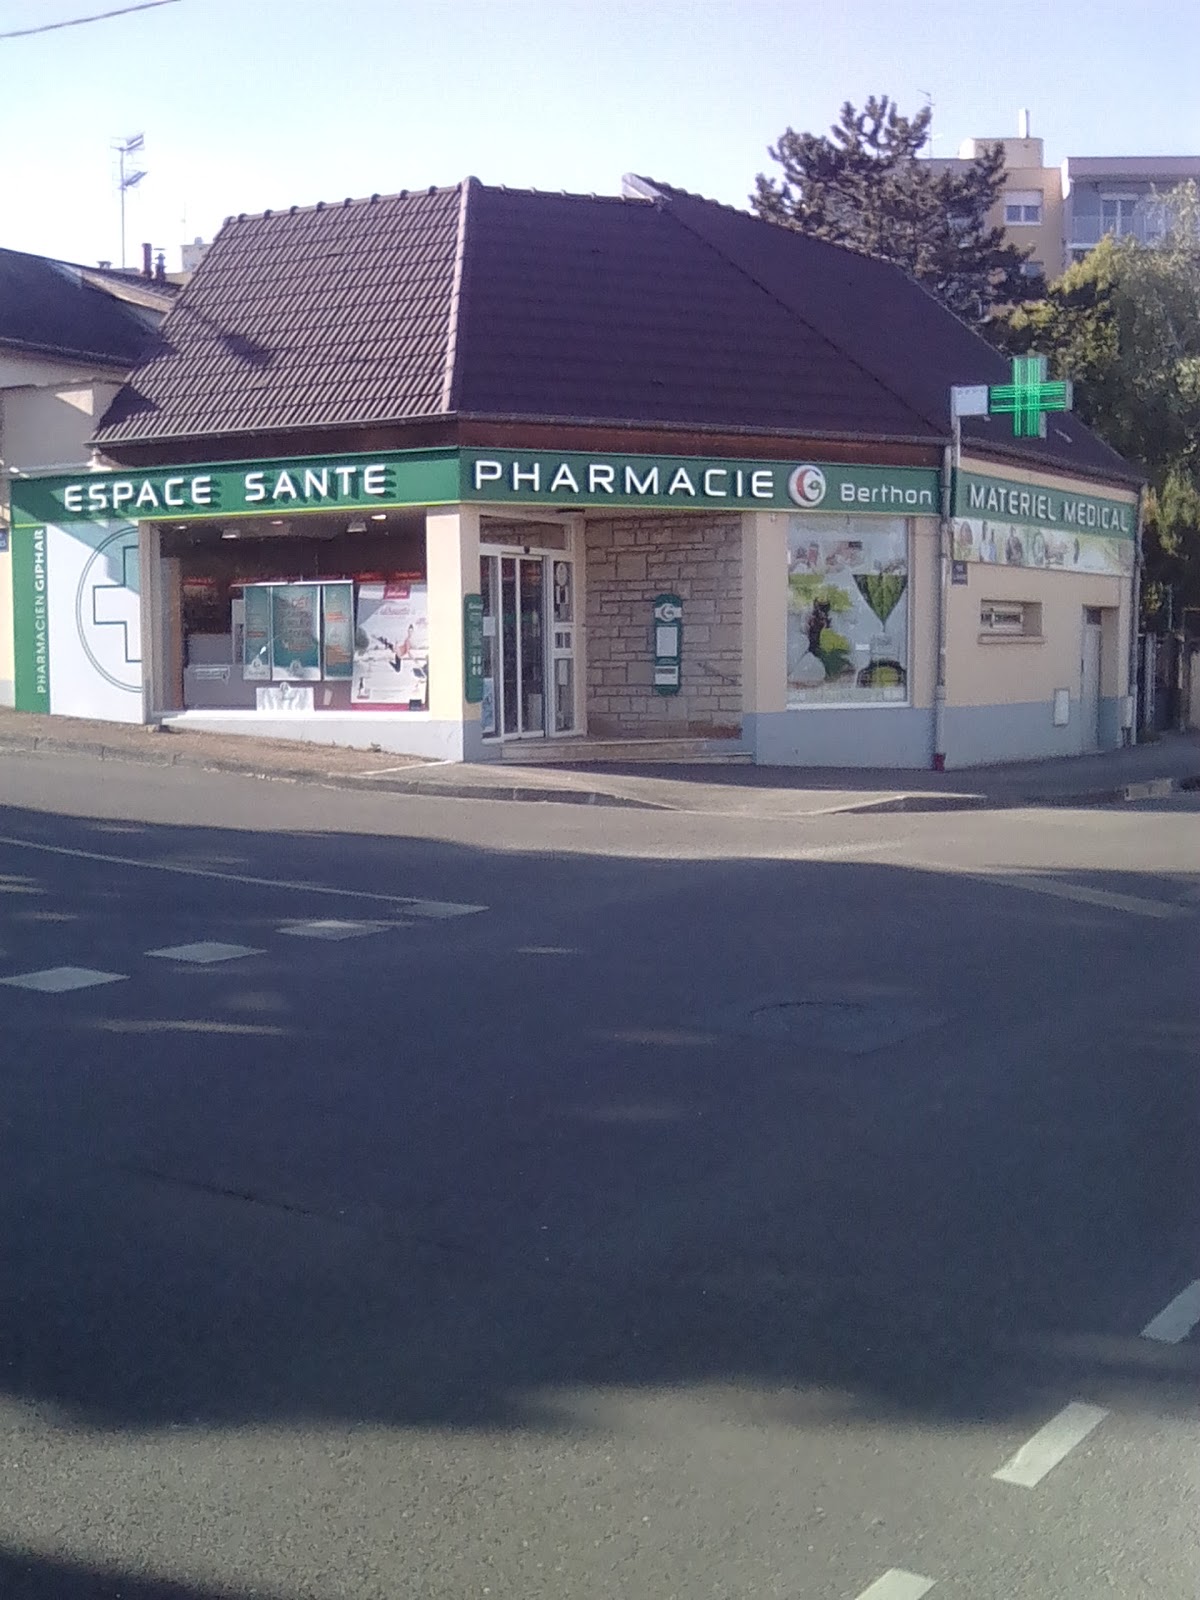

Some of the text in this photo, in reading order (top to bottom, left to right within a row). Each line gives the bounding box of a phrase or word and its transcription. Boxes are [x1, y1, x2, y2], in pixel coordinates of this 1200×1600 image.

[64, 464, 386, 512] ESPACE SANTE
[475, 459, 774, 499] PHARMACIE
[841, 484, 933, 506] Berthon
[969, 482, 1129, 533] MATERIEL MEDICAL
[34, 529, 47, 694] PHARMACIEN GIPHAR
